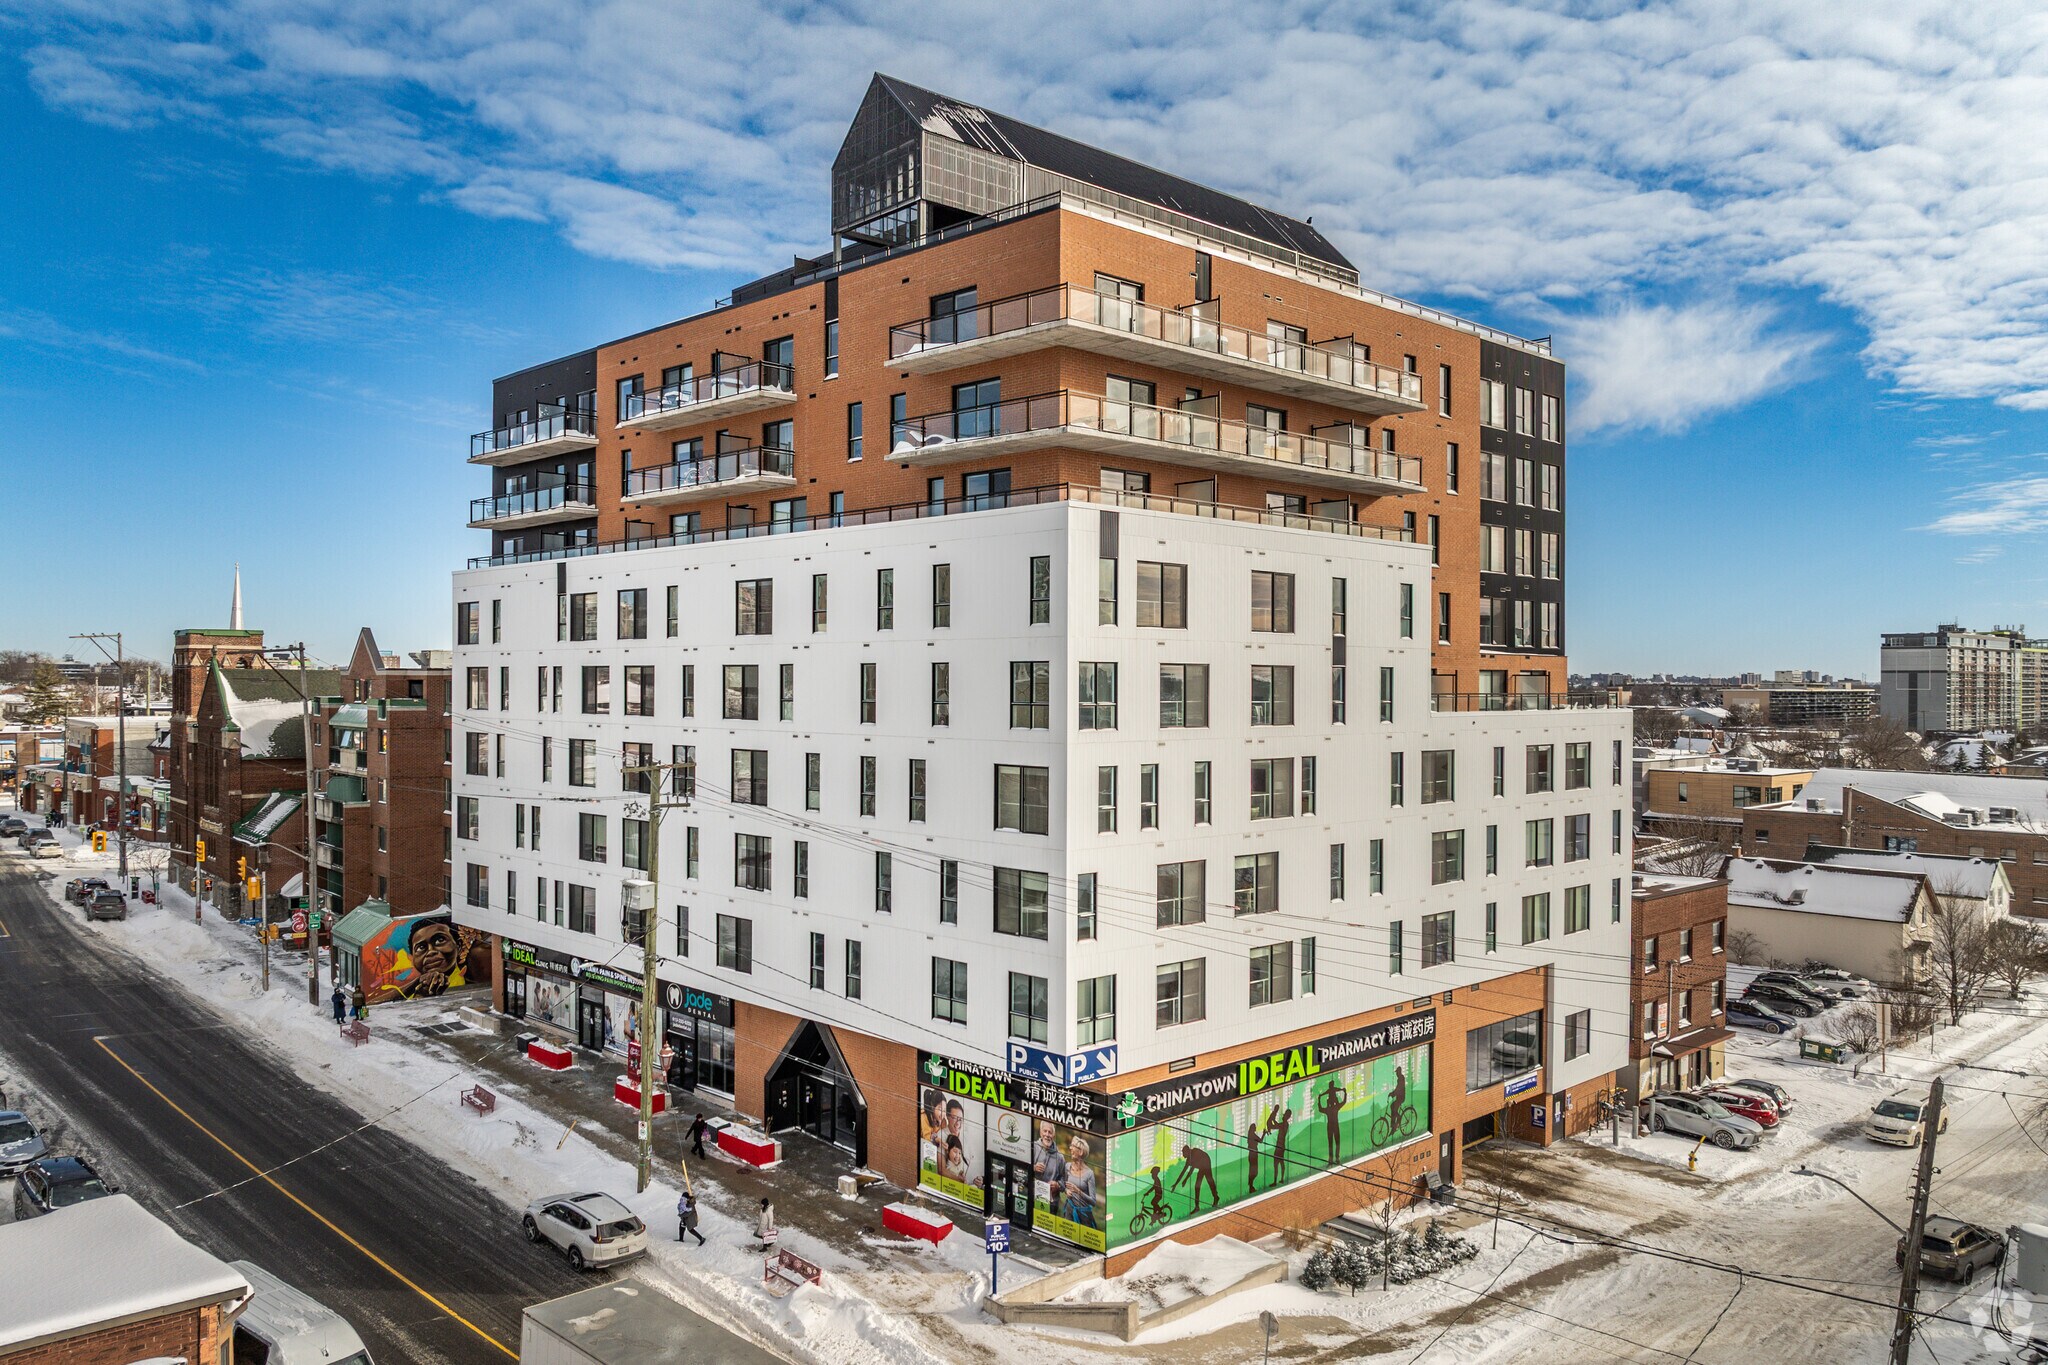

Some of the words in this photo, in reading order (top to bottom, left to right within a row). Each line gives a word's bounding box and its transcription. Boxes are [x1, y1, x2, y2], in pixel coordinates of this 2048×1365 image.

[512, 948, 536, 966] IDEAL
[535, 959, 549, 969] CLINIC
[684, 988, 713, 1011] jade
[688, 1007, 716, 1020] DENTAL
[1388, 1015, 1434, 1046] 精诚药房
[1011, 1044, 1028, 1072] P
[1069, 1054, 1087, 1084] P
[948, 1058, 1012, 1084] CHINATOWN
[1018, 1067, 1039, 1078] PUBLIC
[1077, 1073, 1095, 1082] PUBLIC
[1146, 1072, 1237, 1113] CHINATOWN
[1239, 1045, 1320, 1096] IDEAL
[1321, 1031, 1387, 1063] PHARMACY
[948, 1069, 1012, 1108] IDEAL
[1024, 1079, 1091, 1115] 精诚药房
[1021, 1099, 1093, 1131] PHARMACY
[1533, 1107, 1544, 1120] P
[993, 1225, 1002, 1235] P
